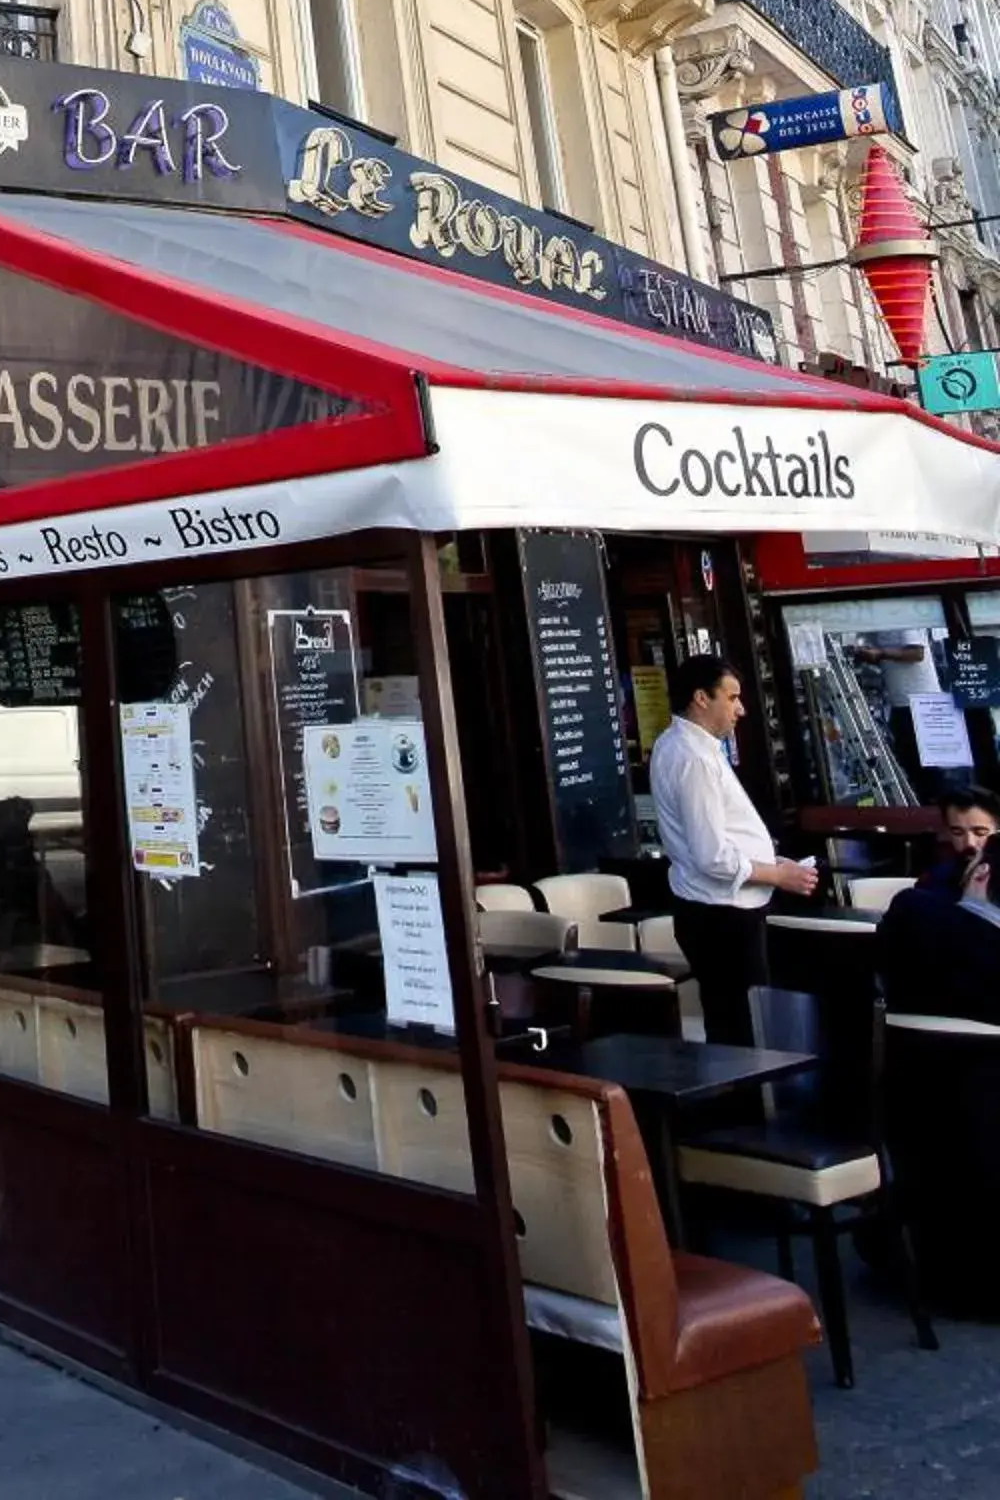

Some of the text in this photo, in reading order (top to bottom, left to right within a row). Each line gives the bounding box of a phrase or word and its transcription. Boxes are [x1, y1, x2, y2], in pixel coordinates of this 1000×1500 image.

[51, 87, 243, 185] BAR
[778, 119, 837, 137] DES JEUX
[634, 422, 856, 500] Cocktails
[39, 522, 129, 567] Resto
[169, 503, 282, 550] Bistro
